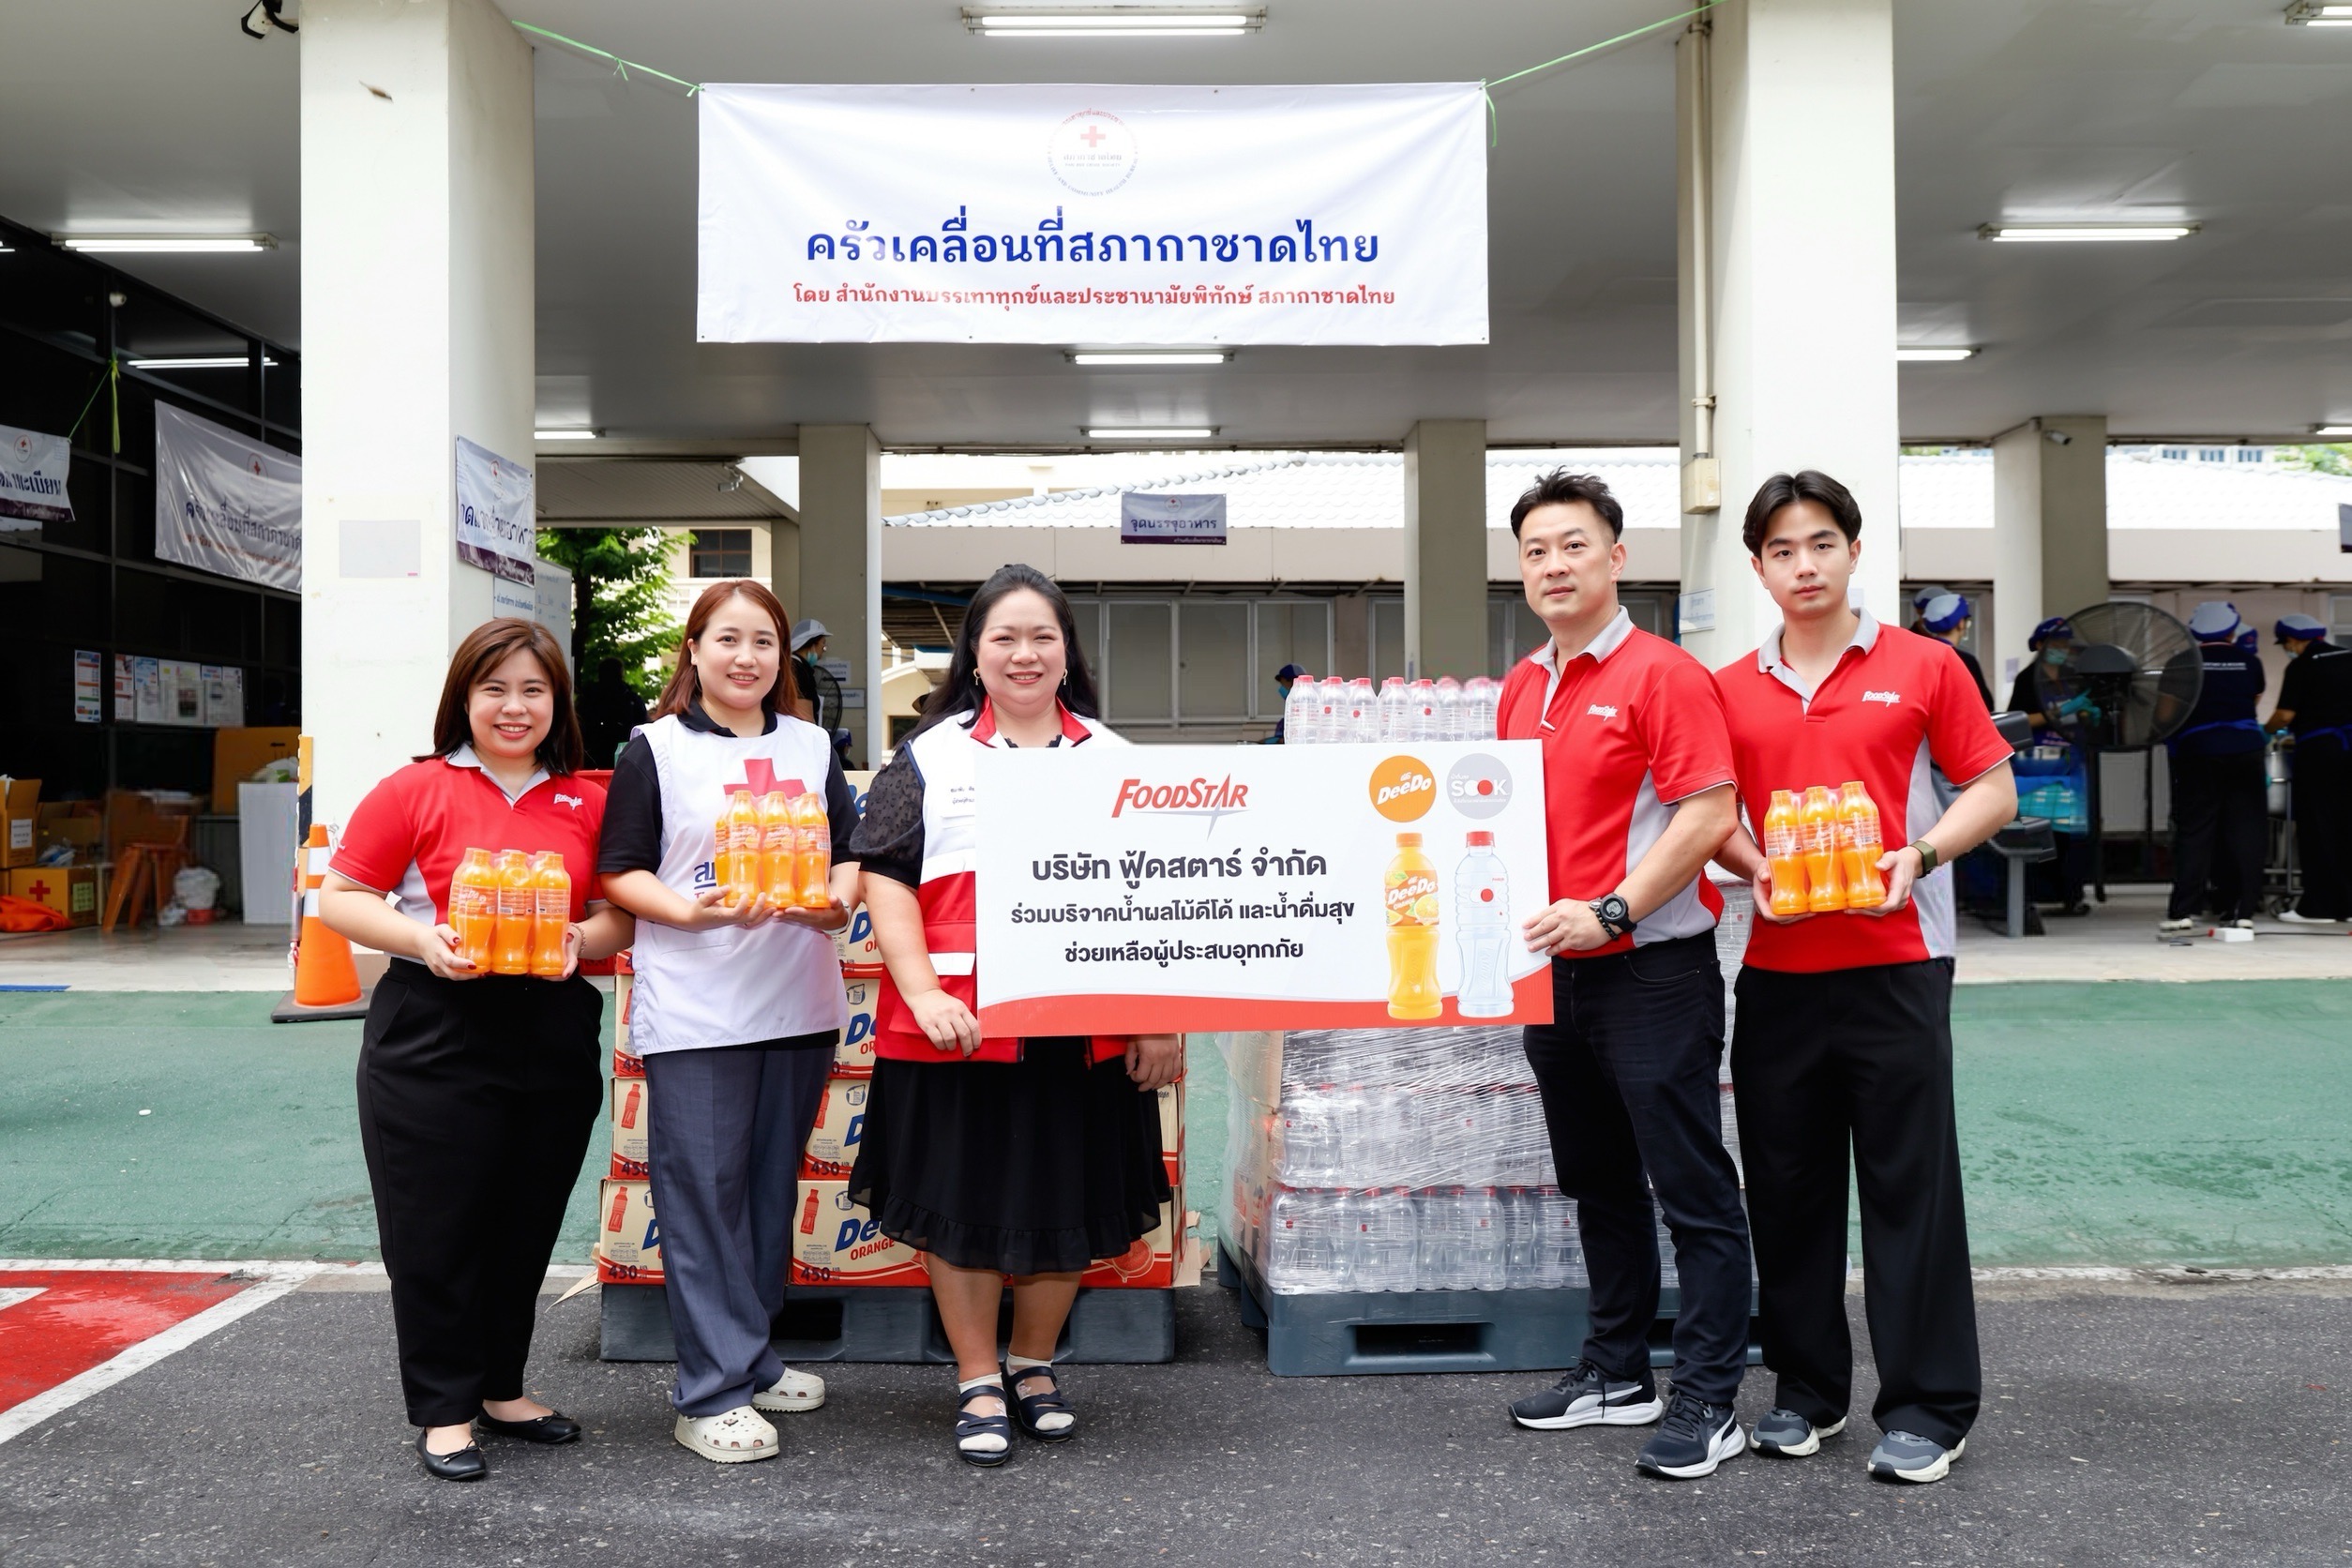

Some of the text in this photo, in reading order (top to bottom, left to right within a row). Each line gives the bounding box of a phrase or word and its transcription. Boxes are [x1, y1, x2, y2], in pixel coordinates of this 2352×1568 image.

[807, 204, 1380, 264] ครัวเคลื่อนที่สภากาชาดไทย
[792, 282, 831, 303] โดย
[1258, 284, 1395, 305] สภากาชาดไทย
[1377, 774, 1433, 805] DeeDo
[1451, 779, 1508, 796] SOOK
[1033, 846, 1327, 890] บริษัท ฟู้ดสตาร์ จำกัด
[1388, 877, 1436, 905] DeeDo
[1011, 891, 1355, 925] ร่วมบริจาคน้ำผลไม้ดีโด้ และน้ำดื่มสุข
[1064, 938, 1304, 969] ช่วยเหลือผู้ประสบอุทกภัย
[850, 1238, 896, 1260] ORANGE
